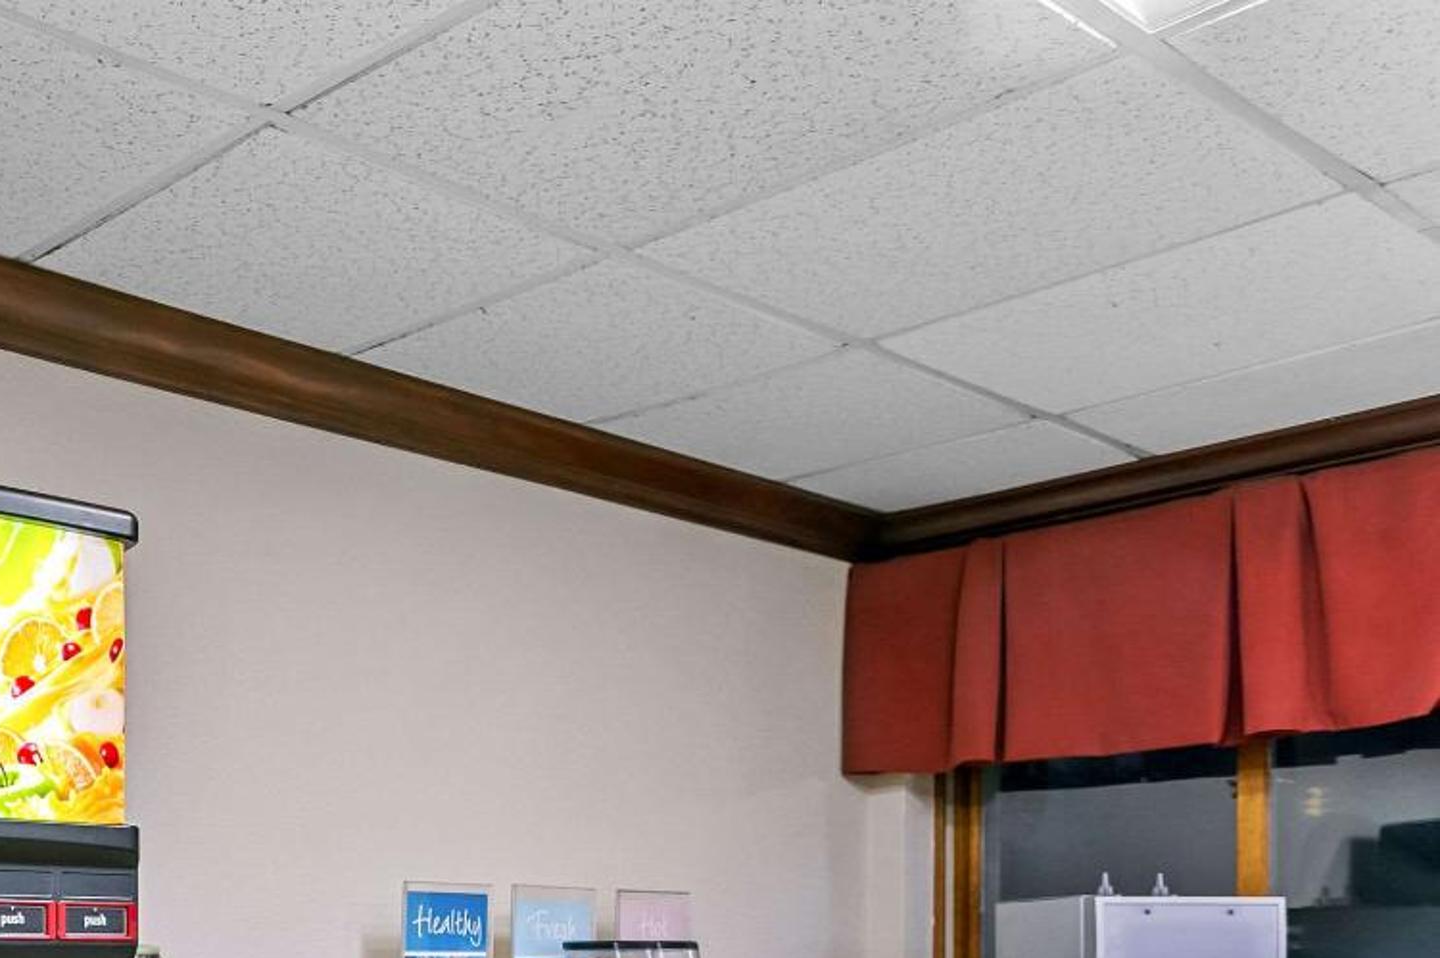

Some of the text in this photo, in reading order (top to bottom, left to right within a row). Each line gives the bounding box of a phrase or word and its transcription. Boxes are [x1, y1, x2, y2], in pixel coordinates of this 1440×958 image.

[0, 912, 26, 928] push
[83, 914, 107, 928] push
[412, 905, 483, 947] Healthy
